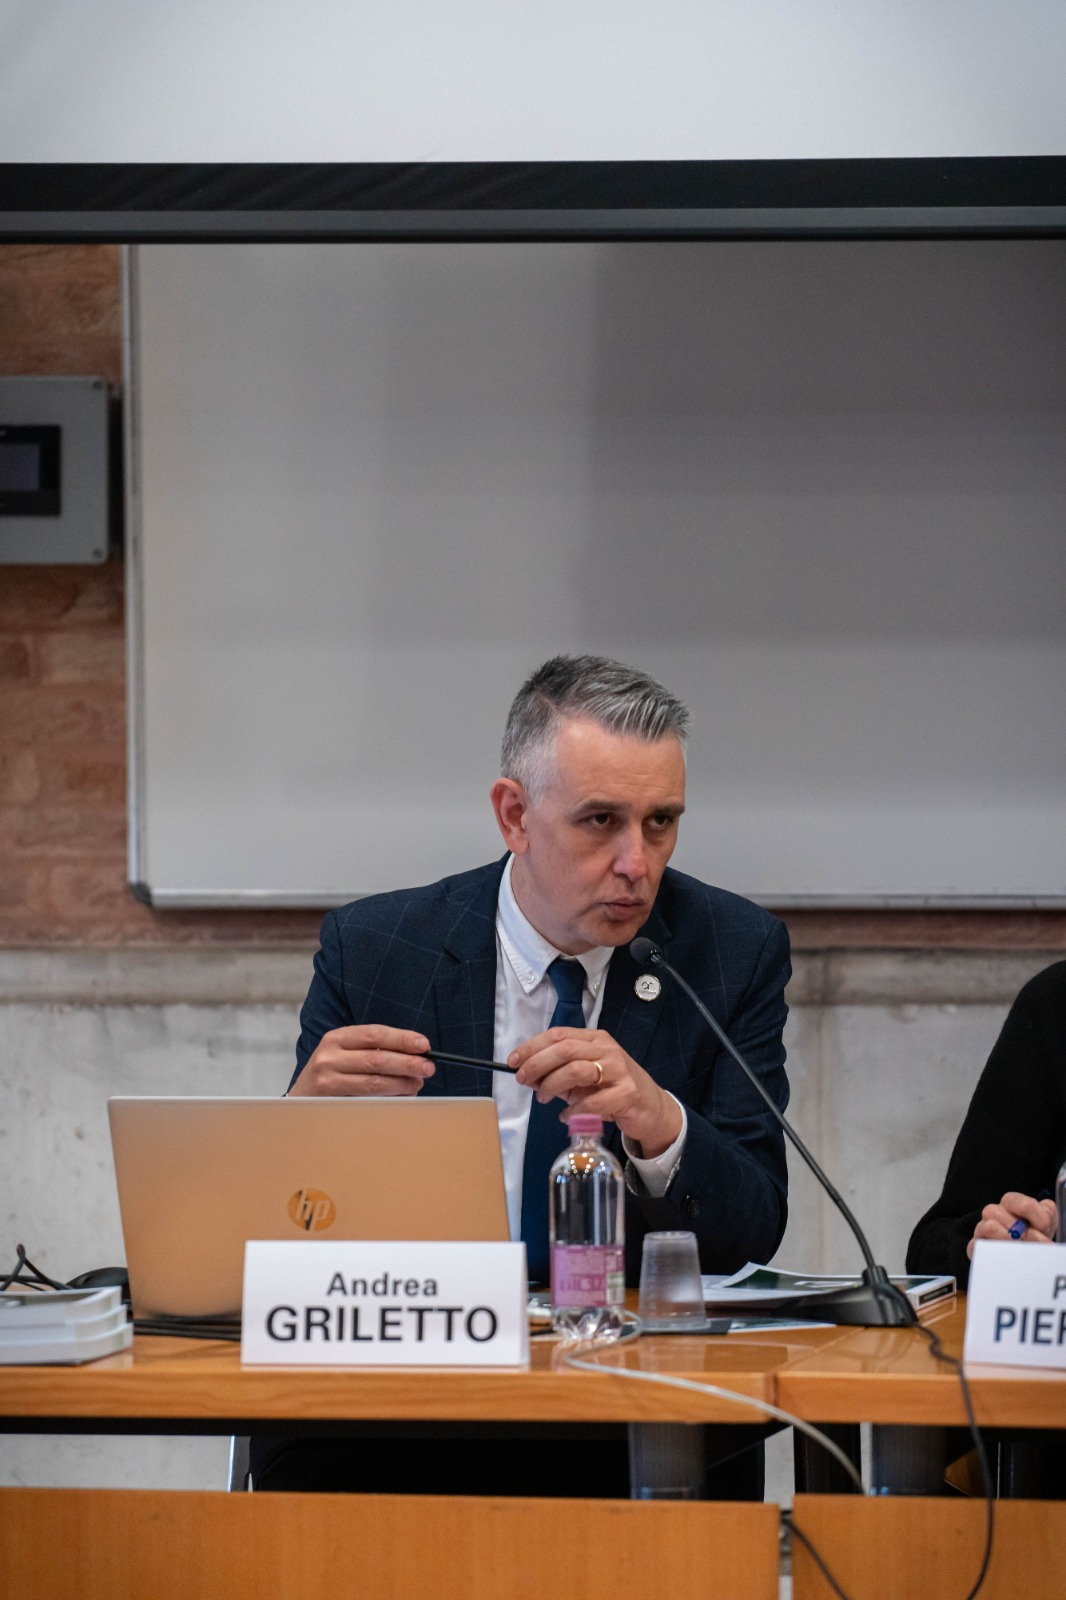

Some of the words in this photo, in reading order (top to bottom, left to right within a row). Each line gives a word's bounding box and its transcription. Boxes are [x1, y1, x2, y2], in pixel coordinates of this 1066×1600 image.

[293, 1187, 332, 1232] hp
[327, 1272, 438, 1296] Andrea
[266, 1306, 498, 1342] GRILETTO
